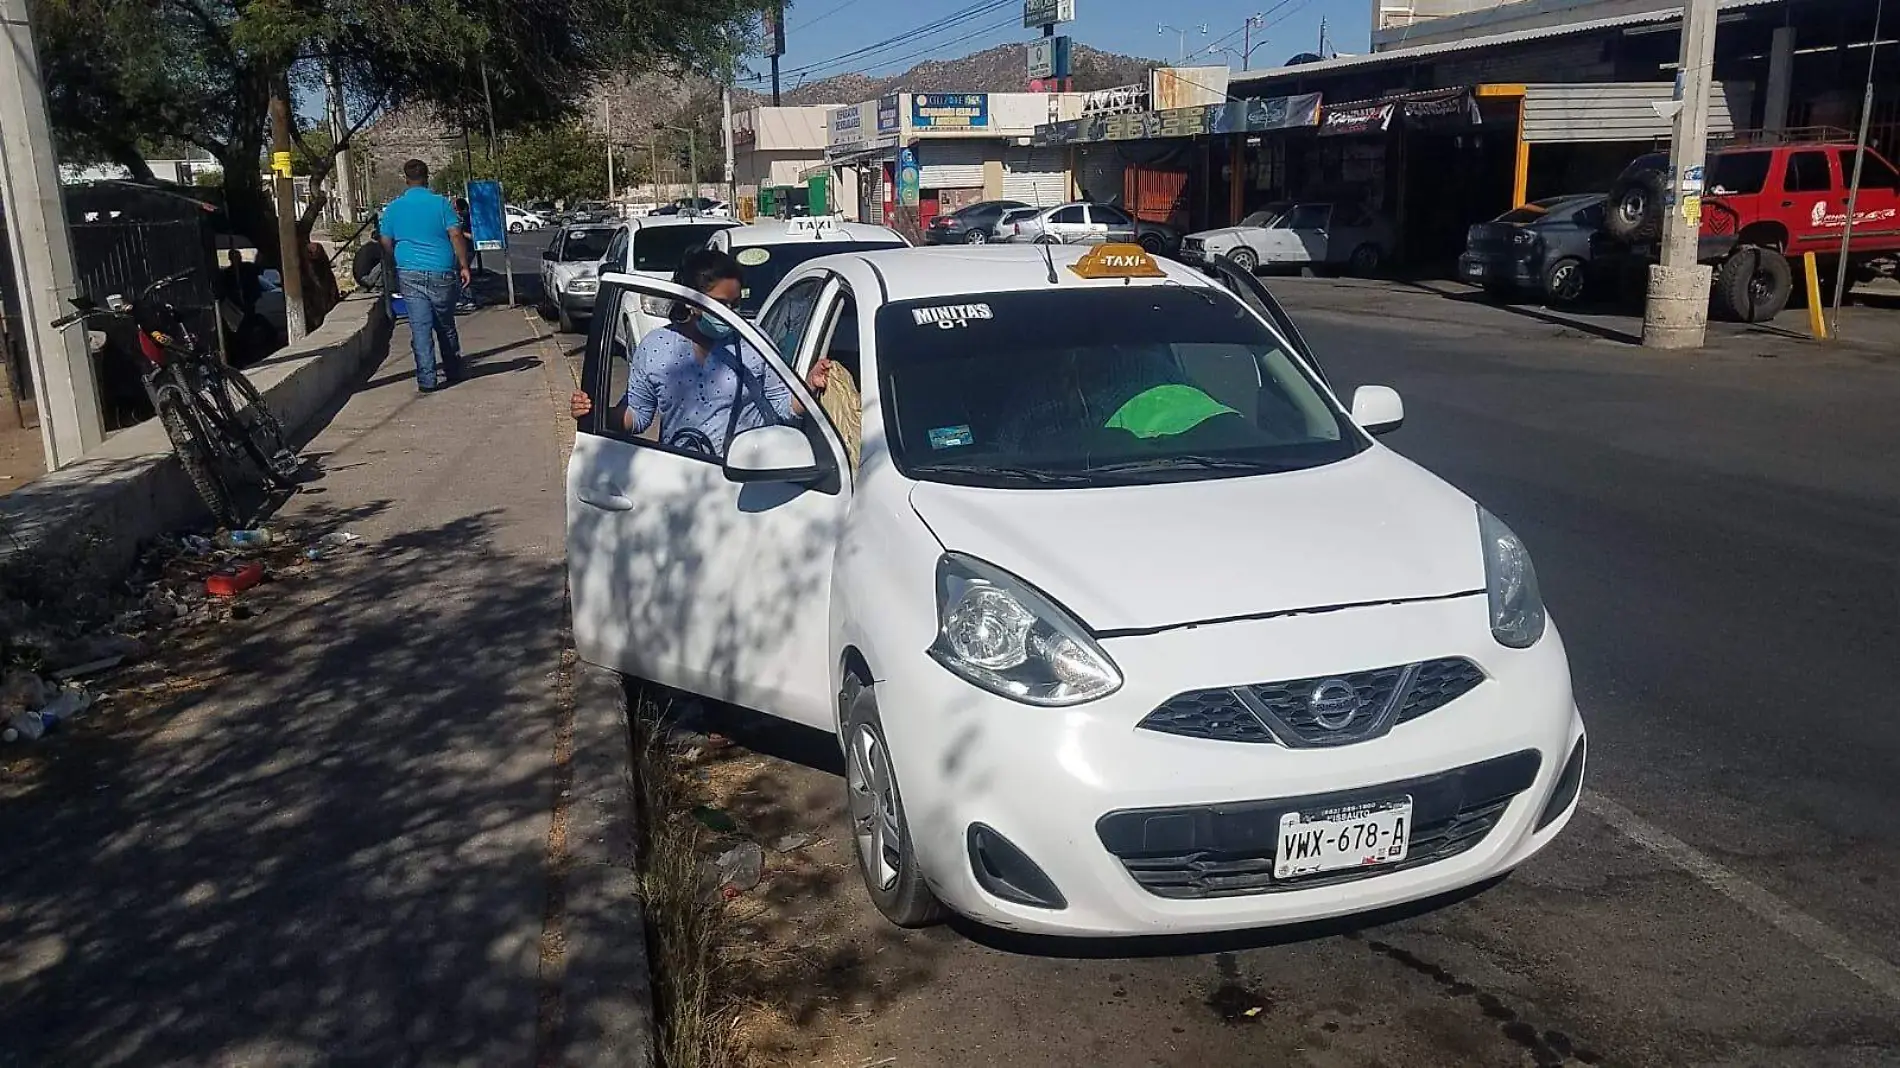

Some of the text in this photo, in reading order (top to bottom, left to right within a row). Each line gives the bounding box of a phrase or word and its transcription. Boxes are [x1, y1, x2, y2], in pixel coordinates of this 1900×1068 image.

[797, 220, 831, 230] TAXI
[1106, 255, 1140, 267] TAXI
[912, 303, 994, 325] MINITAS
[938, 319, 968, 330] 01
[1284, 816, 1405, 861] VWX-678-A
